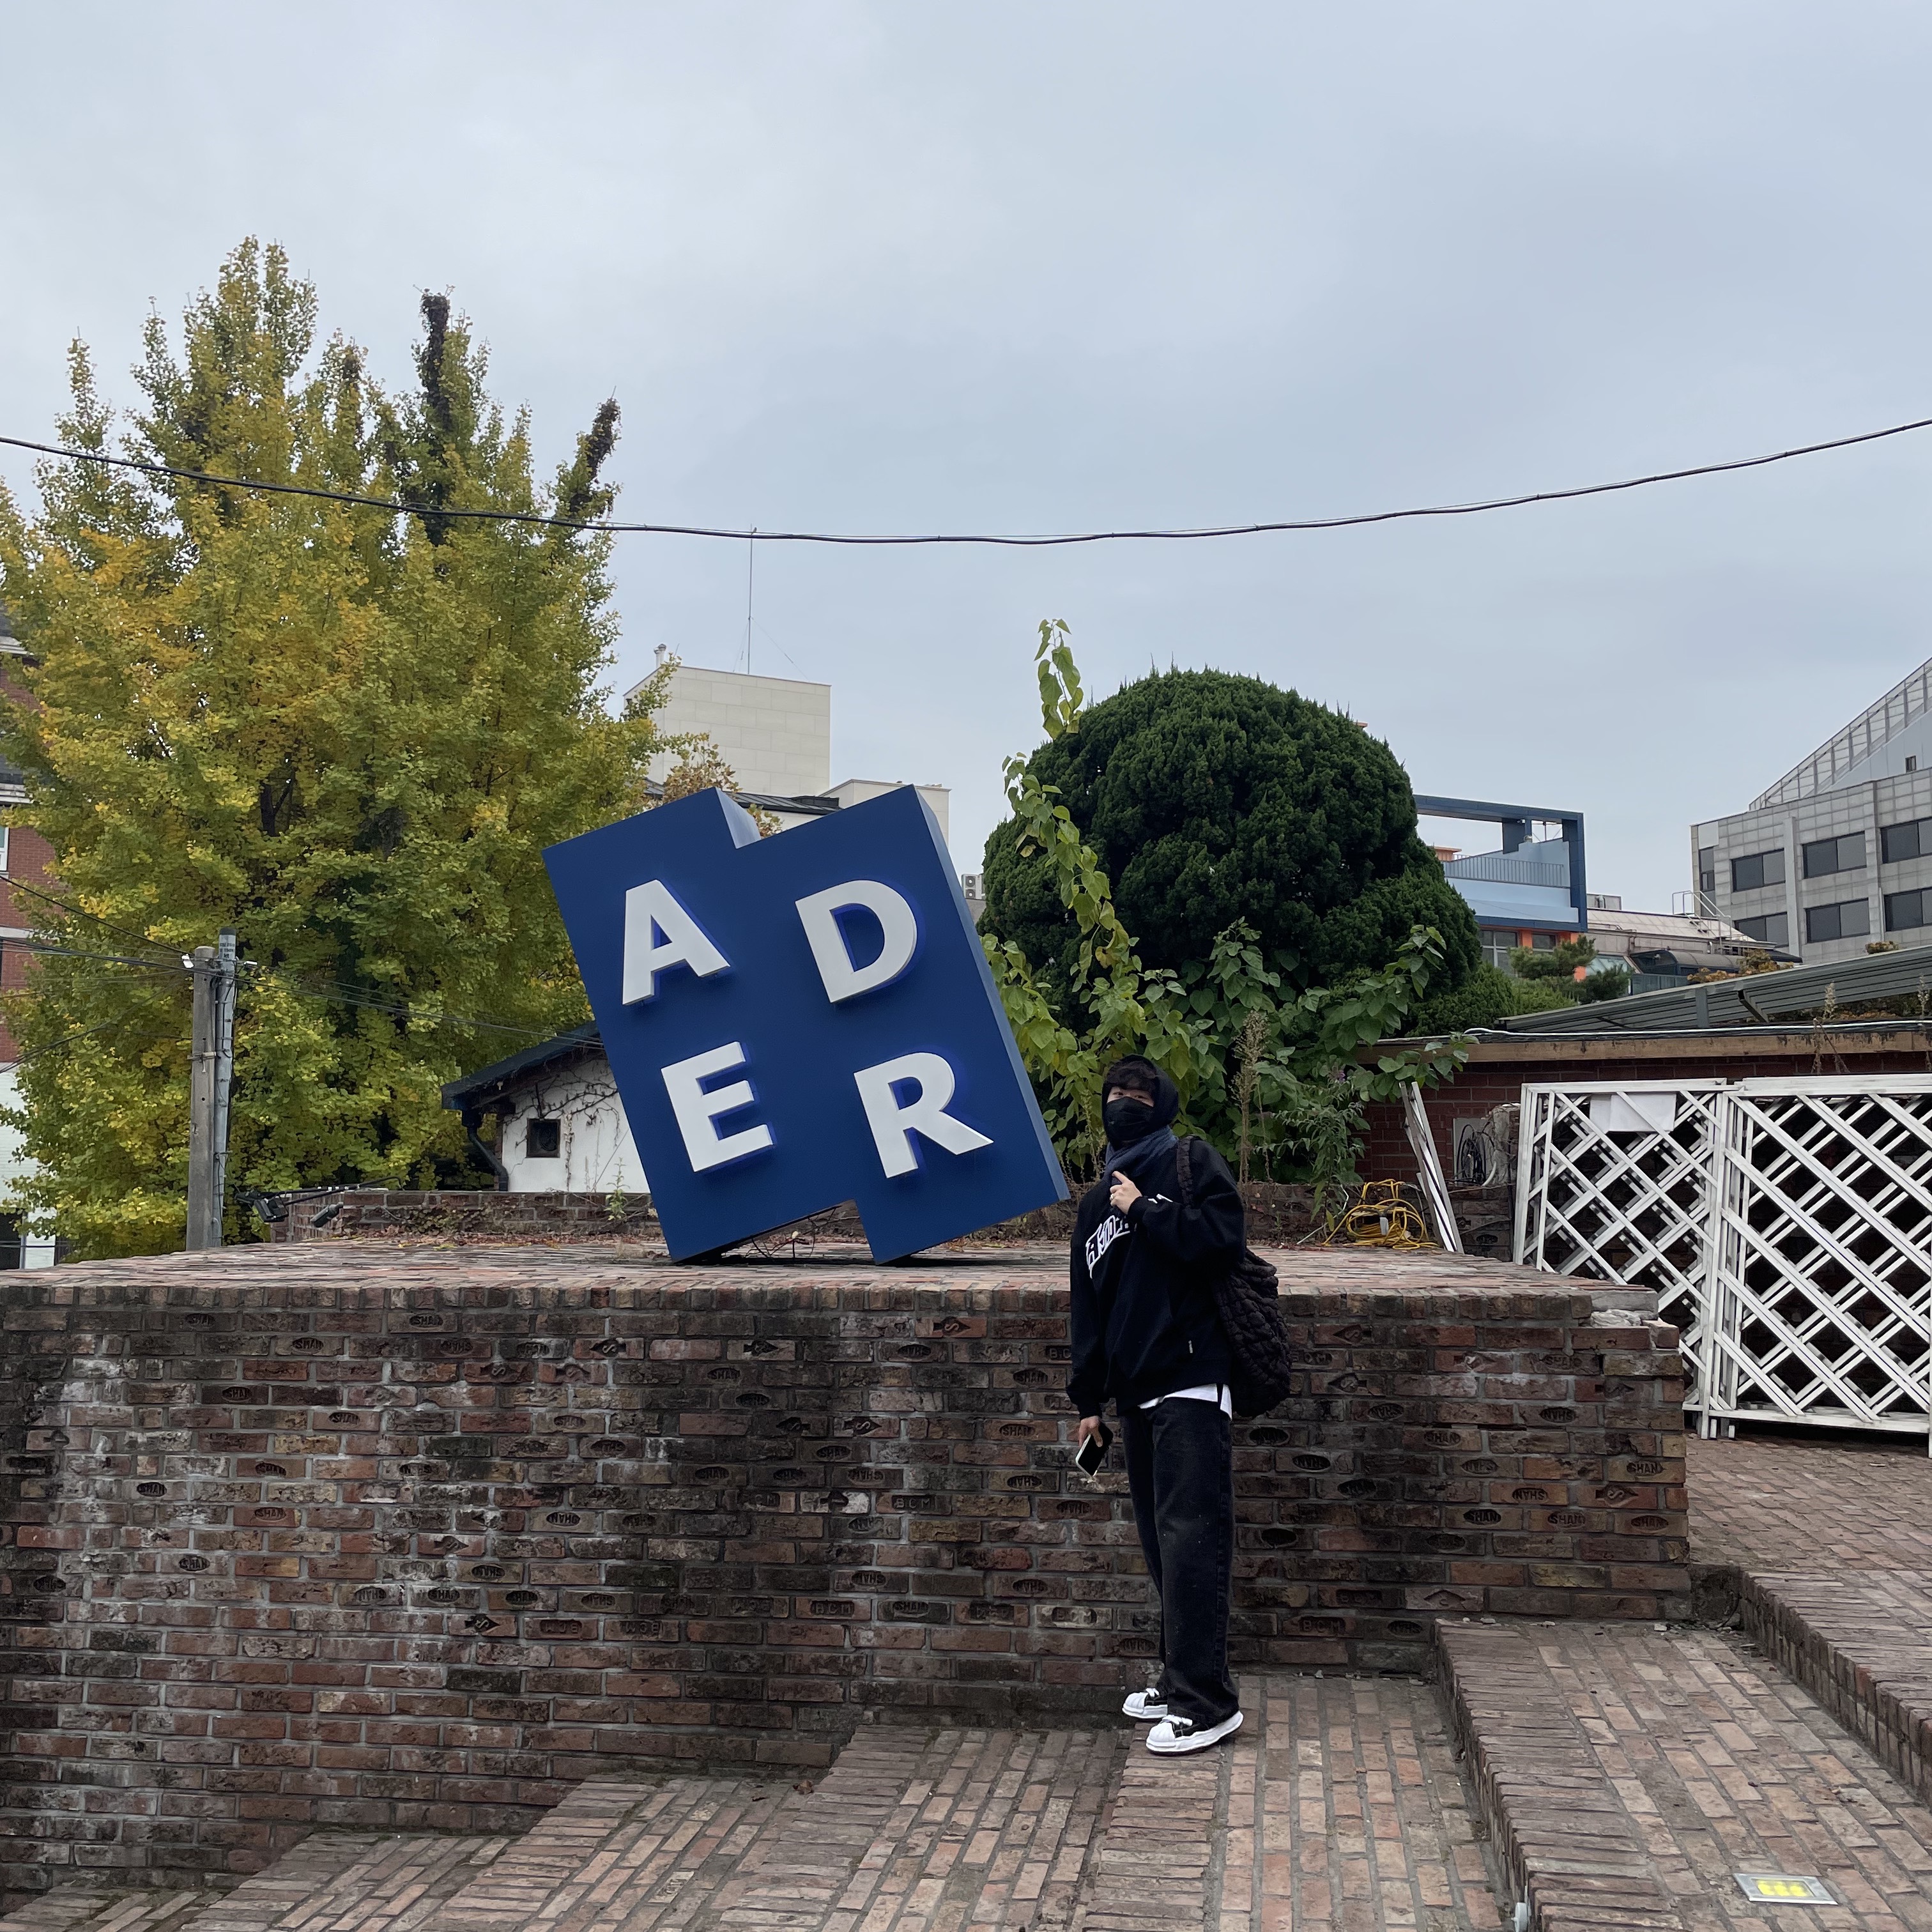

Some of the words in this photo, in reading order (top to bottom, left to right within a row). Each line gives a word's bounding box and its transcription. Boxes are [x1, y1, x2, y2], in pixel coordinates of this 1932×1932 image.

[944, 1323, 960, 1331] S
[602, 1344, 617, 1354] S
[1049, 1348, 1071, 1360] BC
[1513, 1489, 1547, 1501] SHAN
[1607, 1490, 1625, 1499] S
[894, 1497, 931, 1508] BCM
[816, 1603, 851, 1615] BCM
